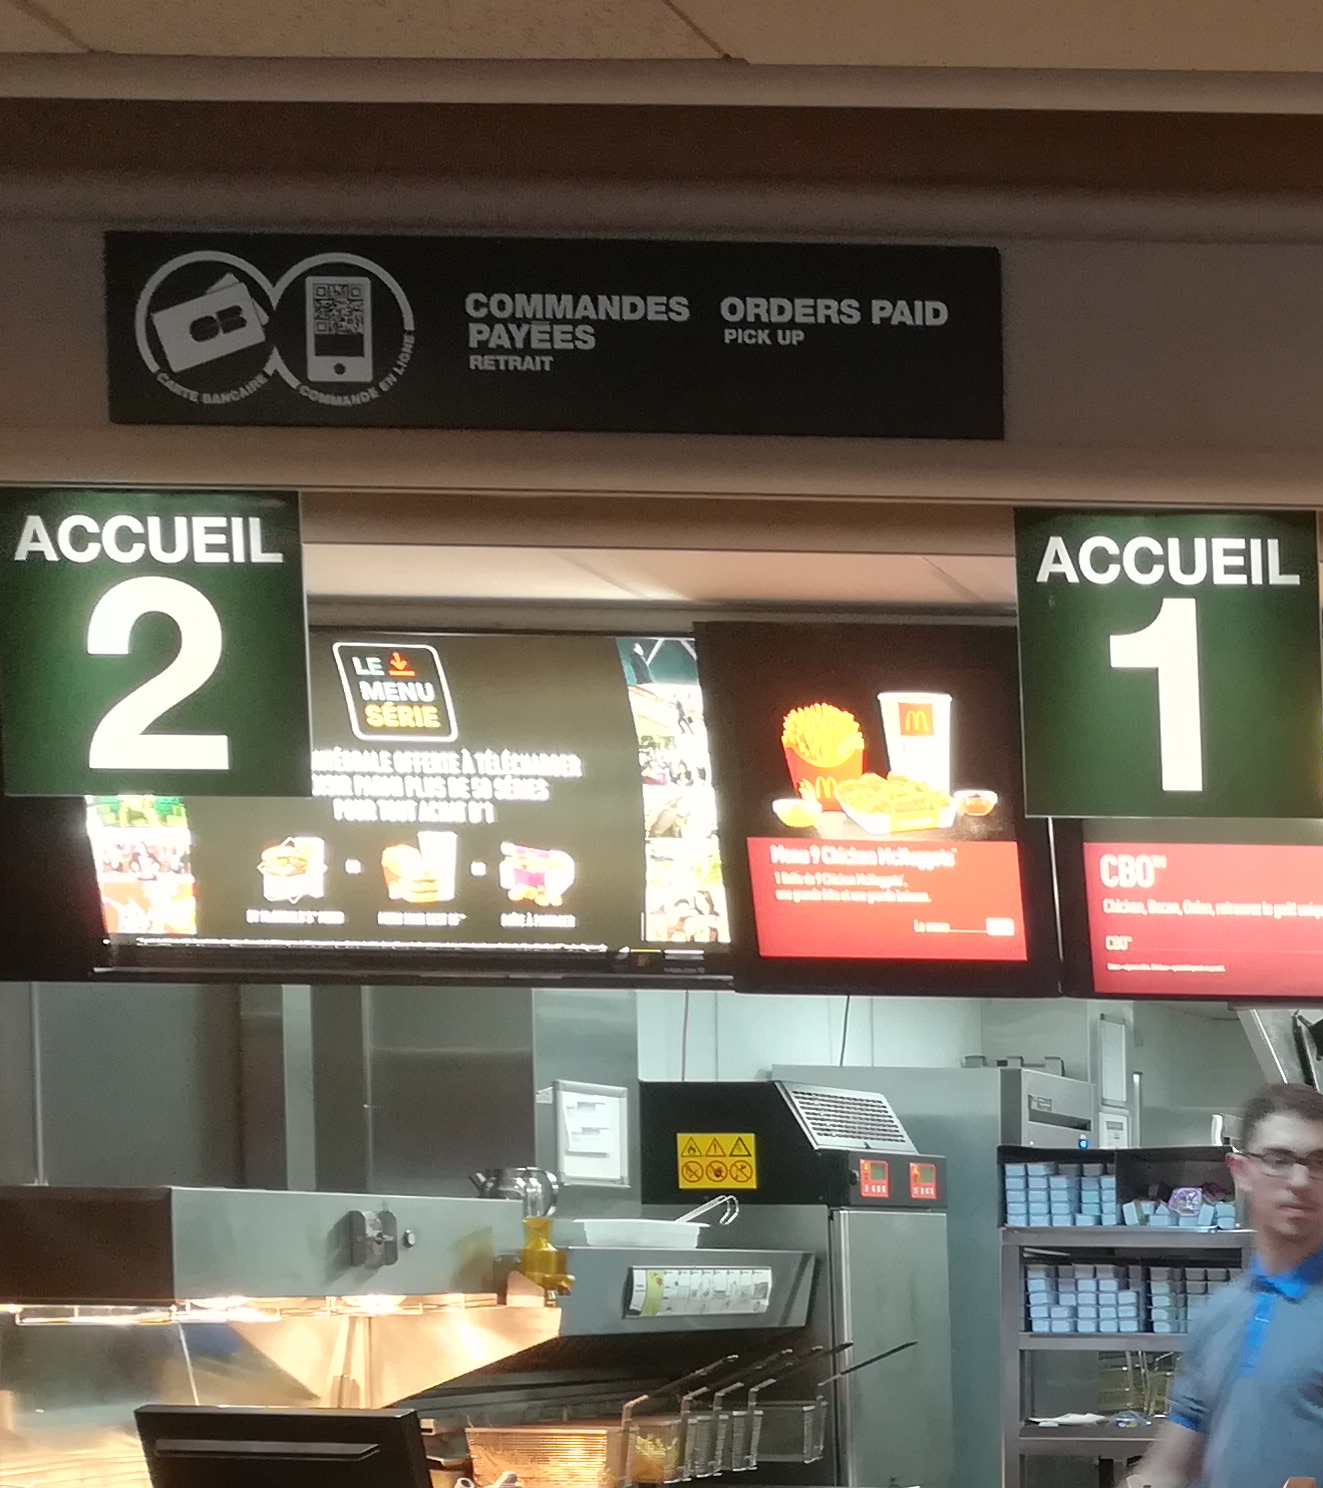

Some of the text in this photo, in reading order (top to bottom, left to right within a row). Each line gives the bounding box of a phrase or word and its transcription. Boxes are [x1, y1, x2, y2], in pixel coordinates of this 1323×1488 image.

[464, 292, 690, 323] COMMANDES
[720, 296, 949, 327] ORDERS PAID
[723, 328, 805, 346] PICK UP
[300, 334, 416, 406] COMMANDE EN LIGNE
[469, 355, 554, 372] RETRAIT
[202, 374, 268, 405] BANCAIRE
[14, 515, 283, 563] ACCUEIL
[1036, 536, 1300, 585] ACCUEIL
[87, 575, 229, 770] 2
[352, 656, 385, 676] LE
[359, 681, 435, 702] MENU
[1110, 598, 1203, 791] 1
[365, 702, 441, 728] SÉRIE
